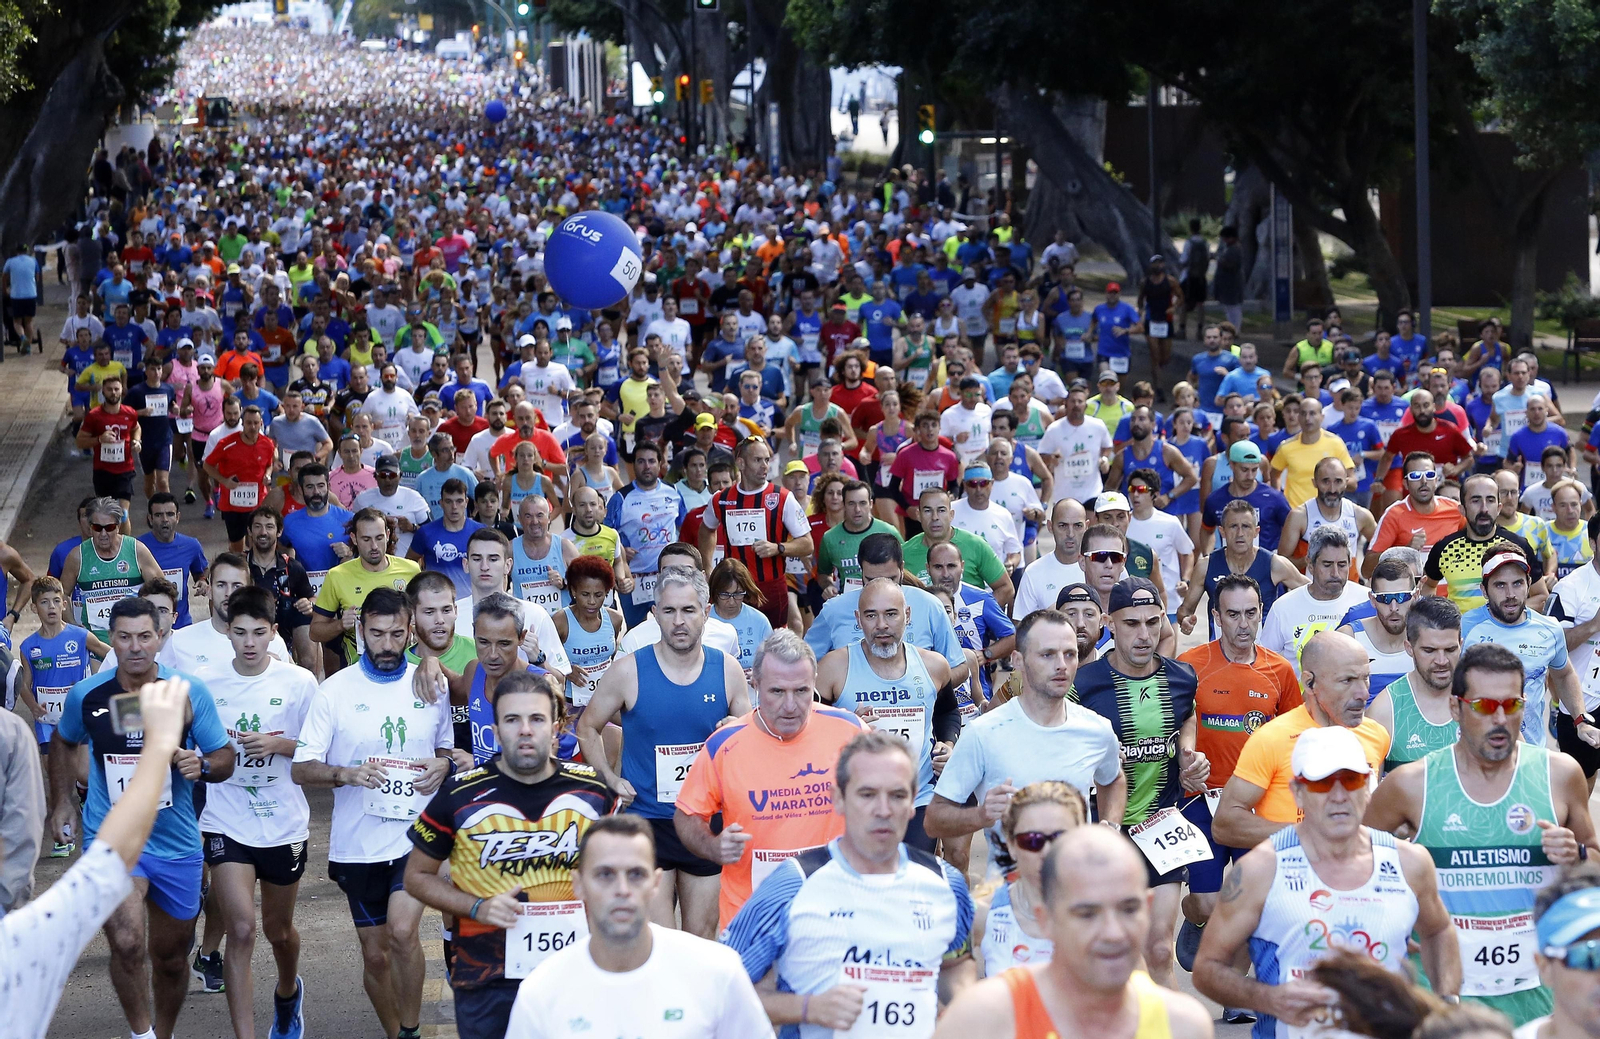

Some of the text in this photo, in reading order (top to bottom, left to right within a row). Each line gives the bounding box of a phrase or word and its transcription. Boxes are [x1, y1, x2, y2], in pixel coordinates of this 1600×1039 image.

[623, 261, 637, 282] 50
[233, 491, 256, 499] 18139
[736, 522, 756, 532] 176
[517, 563, 548, 576] nerja
[92, 579, 129, 591] ATLETISMO
[527, 592, 559, 606] 17910
[97, 608, 111, 619] 43
[572, 644, 610, 656] nerja
[855, 687, 911, 706] nerja
[1207, 716, 1240, 728] MÁLAGA
[658, 745, 697, 756] 41 CARRERA
[1120, 744, 1166, 760] Playuca
[236, 751, 275, 769] 1287
[380, 780, 415, 797] 383
[748, 782, 831, 812] V MEDIA 2018
[770, 796, 832, 811] MARATÓN
[469, 821, 581, 869] TEBA
[1153, 825, 1196, 851] 1584
[755, 852, 767, 861] 41
[768, 851, 799, 859] CARRERA
[1450, 849, 1531, 865] ATLETISMO
[1439, 871, 1543, 888] TORREMOLINOS
[1454, 918, 1469, 929] 41
[1471, 918, 1507, 926] CARRERA
[523, 930, 575, 952] 1564
[1474, 943, 1520, 966] 465
[845, 967, 861, 979] 41
[868, 1001, 915, 1025] 163
